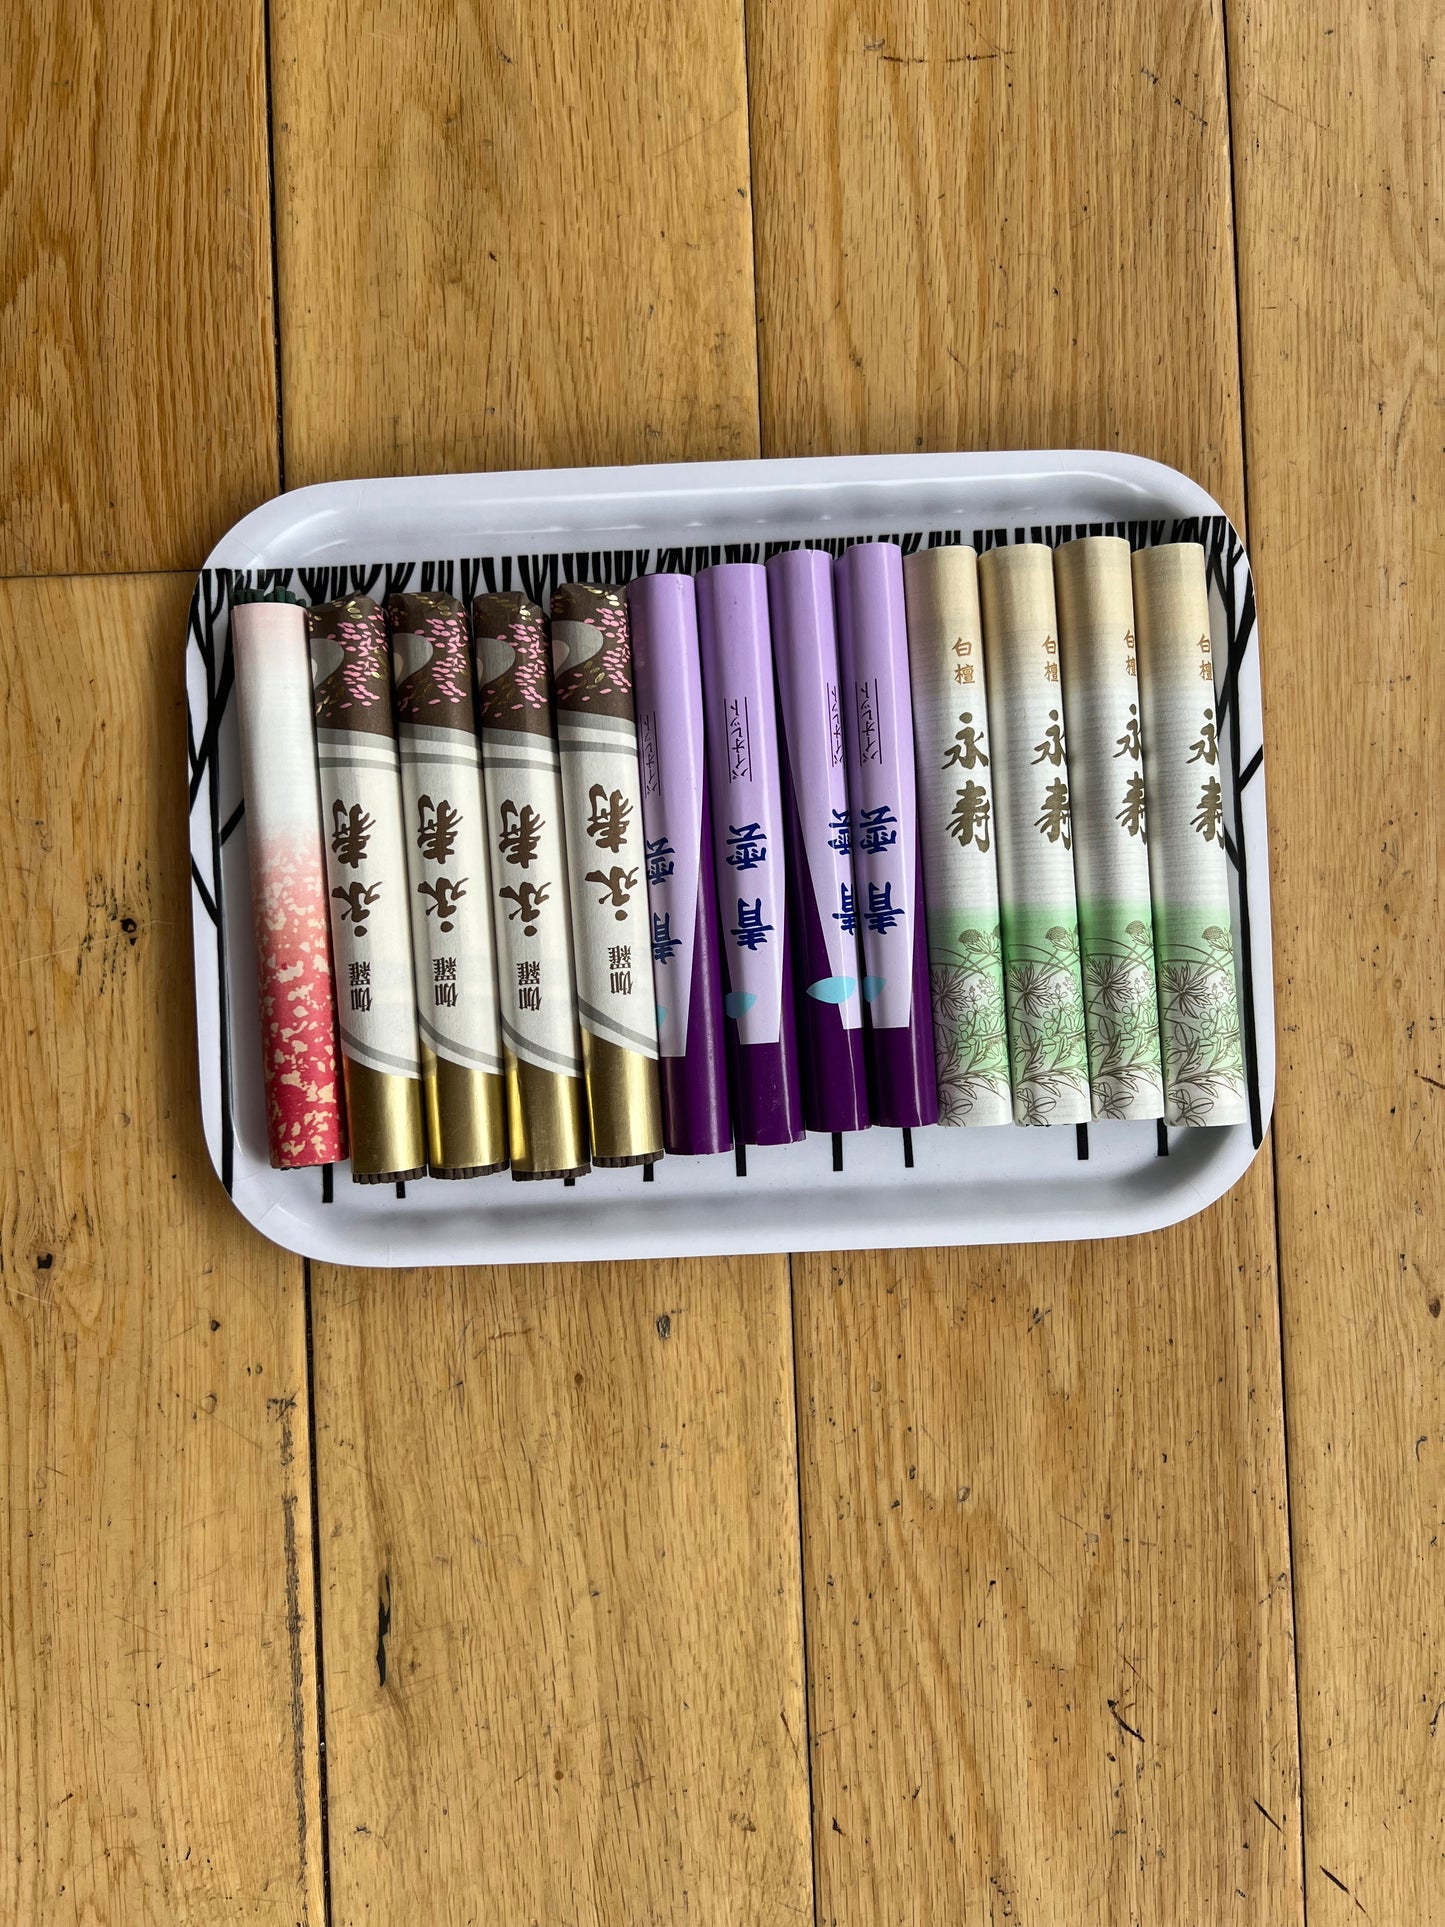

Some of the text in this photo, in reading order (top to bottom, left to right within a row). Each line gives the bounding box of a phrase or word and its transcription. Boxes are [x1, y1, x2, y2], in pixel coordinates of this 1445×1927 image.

[1041, 634, 1060, 683] 白檀
[729, 699, 749, 779] バイオレット
[860, 682, 879, 764] バイオレット
[941, 636, 991, 853] 白檀 永寿
[646, 836, 682, 965] 青雲
[726, 822, 775, 951] 青雲
[860, 804, 905, 935] 青雲
[348, 962, 373, 1011] 伽羅
[432, 956, 459, 1009] 伽羅
[516, 961, 542, 1011] 伽羅
[607, 944, 634, 995] 伽羅
